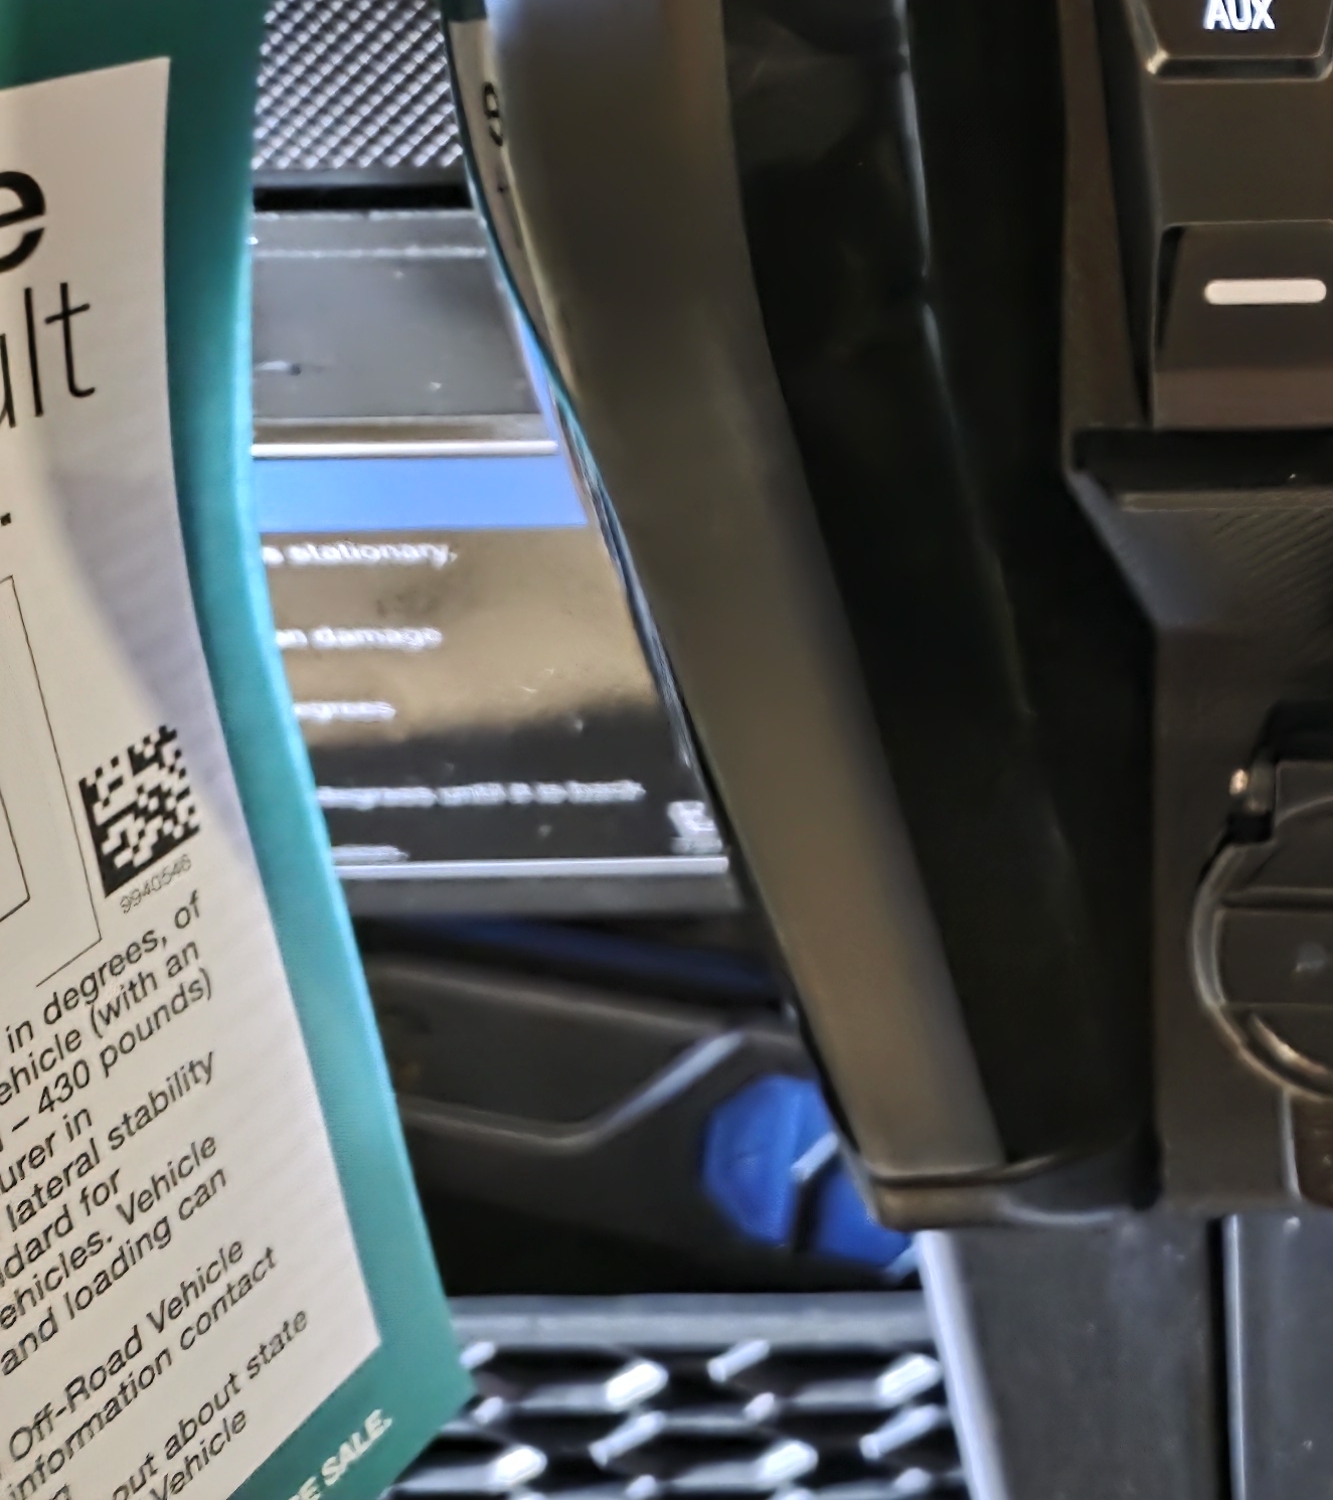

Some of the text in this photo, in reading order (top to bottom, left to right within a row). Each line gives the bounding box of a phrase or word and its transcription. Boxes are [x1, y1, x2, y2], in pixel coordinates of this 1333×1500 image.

[6, 889, 200, 1053] in degrees, of
[38, 1059, 91, 1114] 430
[99, 967, 212, 1078] pounds)
[90, 971, 158, 1038] (with
[166, 941, 199, 979] an
[6, 1051, 213, 1232] lateral stability
[62, 1108, 93, 1142] in
[115, 1136, 217, 1225] Vehicle
[0, 1168, 120, 1288] dard for
[1, 1168, 226, 1376] and loading can
[8, 1247, 277, 1500] information contact
[9, 1240, 244, 1463] Off-Road Vehicle
[164, 1372, 242, 1460] about
[247, 1310, 308, 1380] state
[150, 1410, 247, 1500] Vehicle
